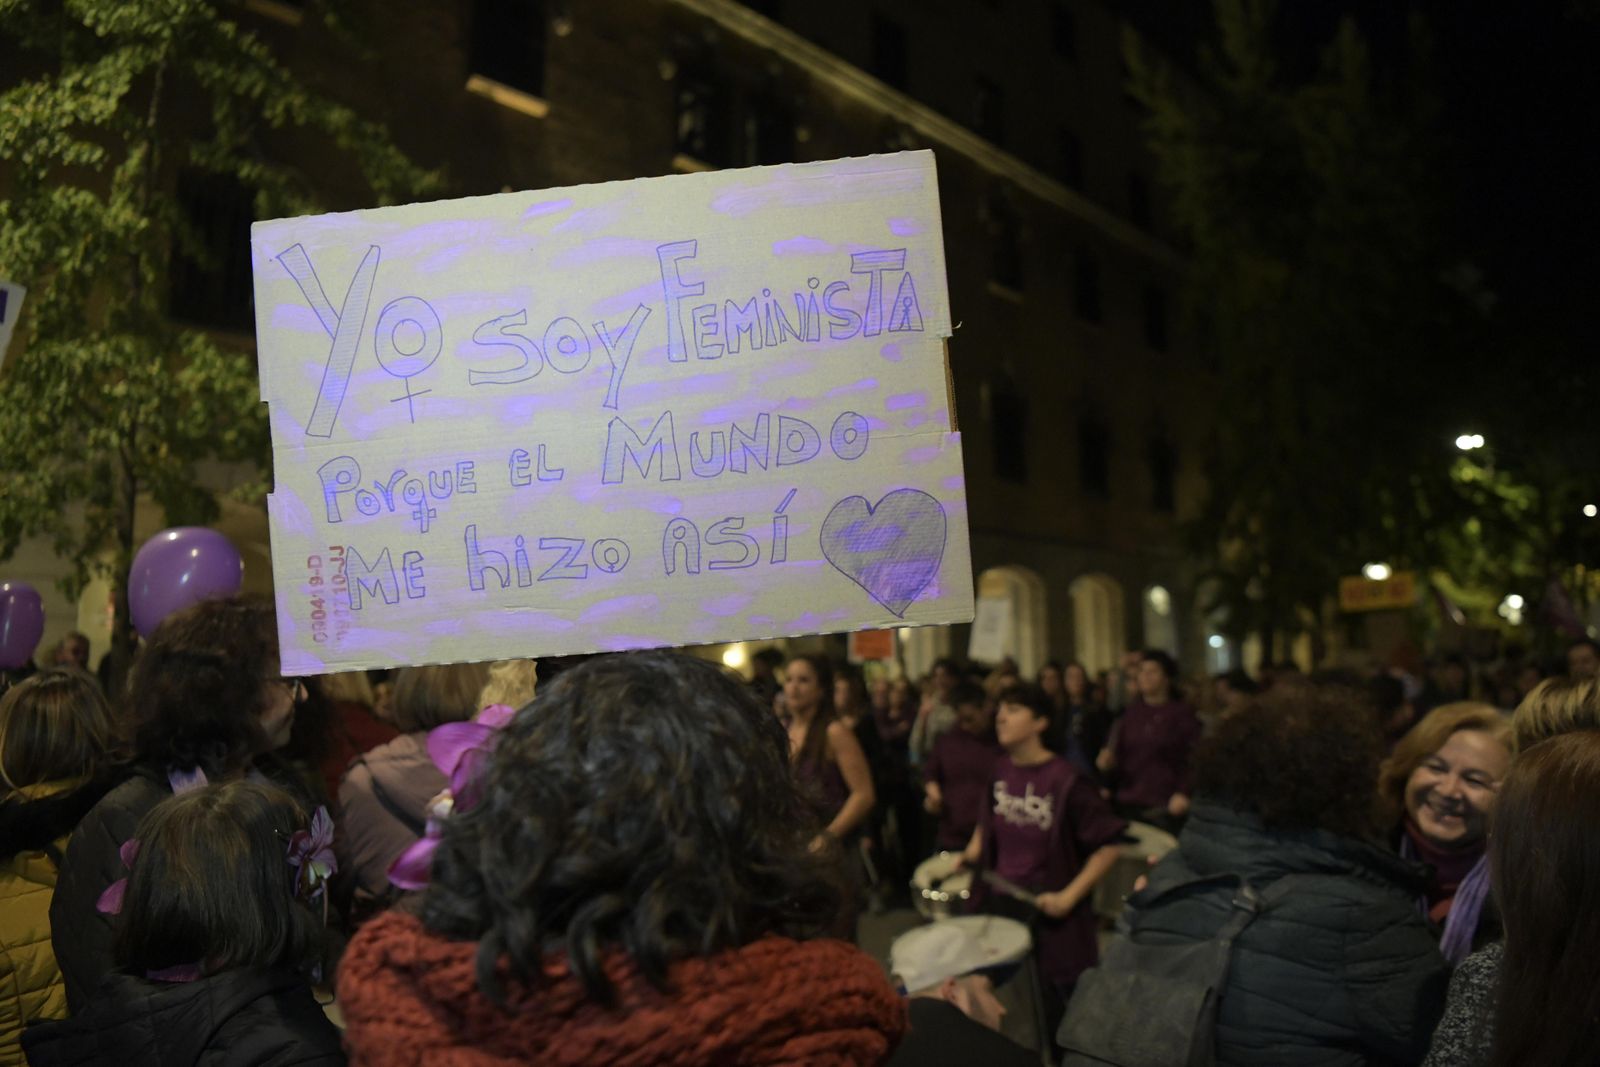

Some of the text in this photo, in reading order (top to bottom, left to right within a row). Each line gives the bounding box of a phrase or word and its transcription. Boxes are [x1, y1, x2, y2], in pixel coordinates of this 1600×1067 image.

[469, 303, 652, 409] SOY
[509, 444, 564, 486] EL
[602, 410, 869, 484] MUNDO
[345, 546, 426, 610] ME
